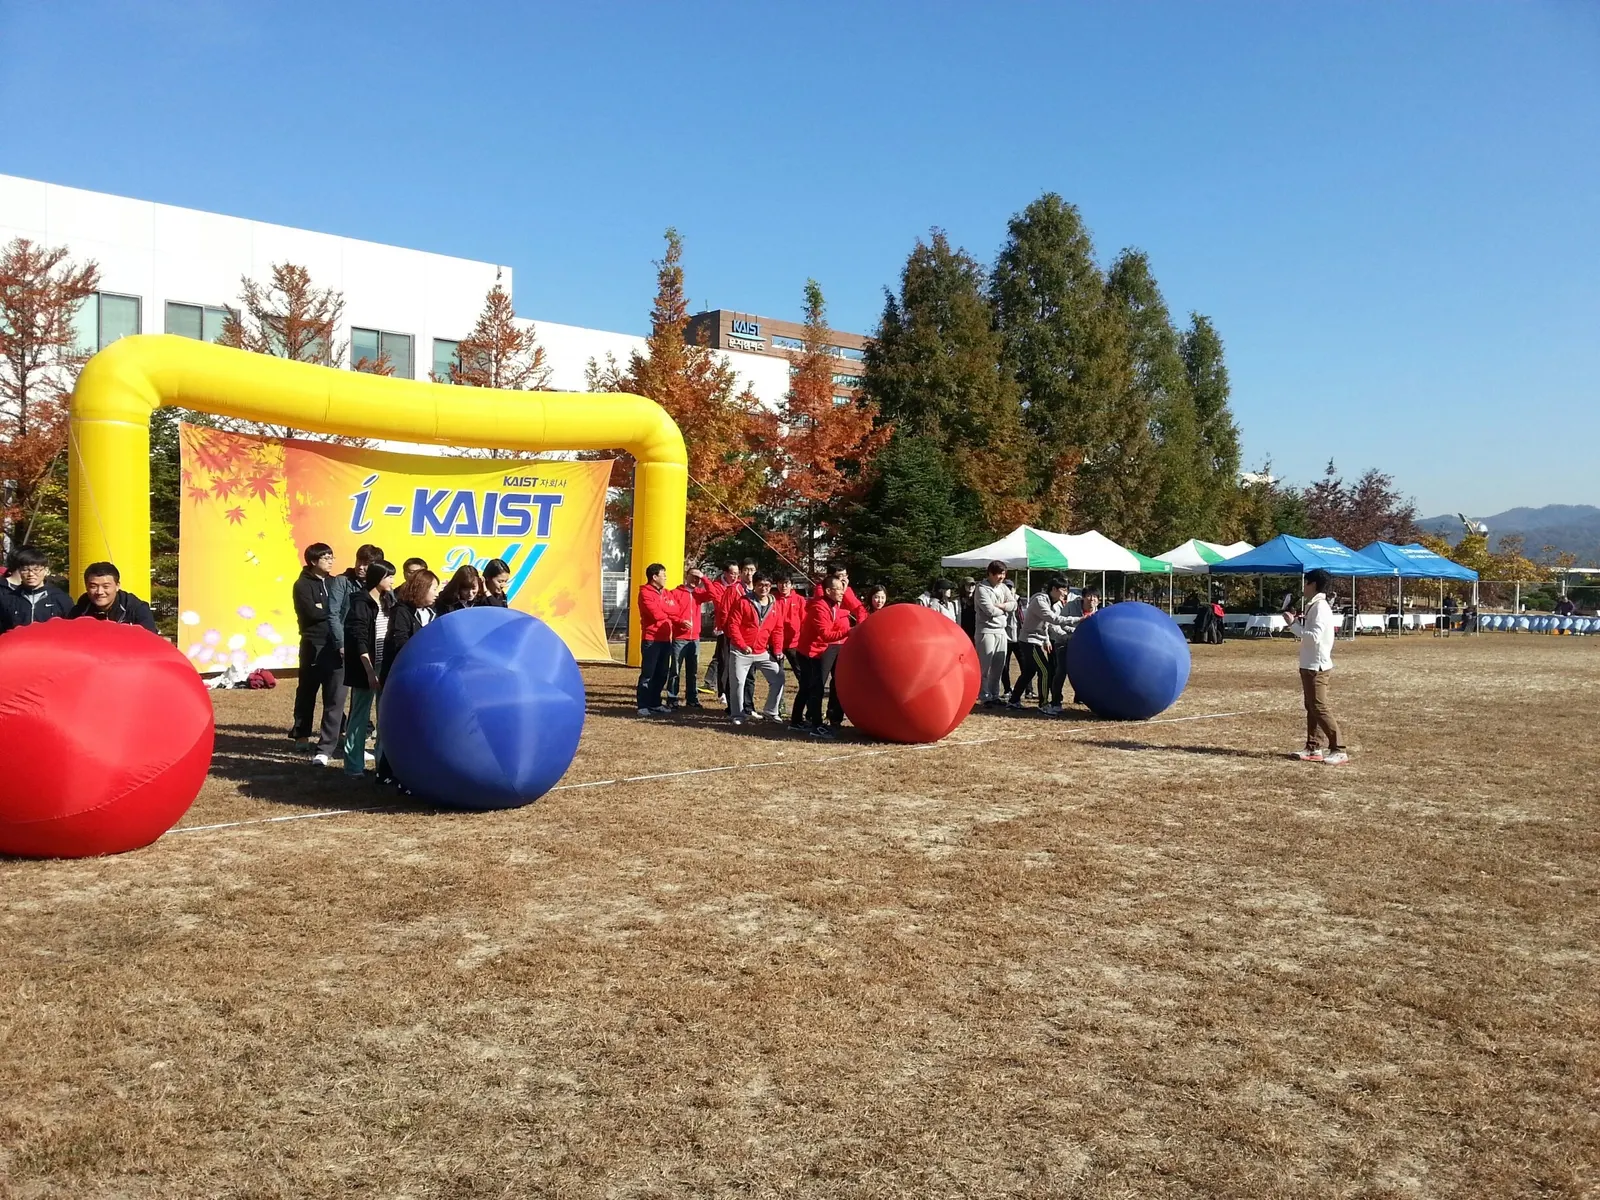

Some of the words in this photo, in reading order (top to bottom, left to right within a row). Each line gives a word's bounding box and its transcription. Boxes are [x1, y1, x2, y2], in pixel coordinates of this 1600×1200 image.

[733, 320, 761, 336] KAIST
[503, 476, 539, 487] KAIST
[540, 479, 567, 488] 자회사
